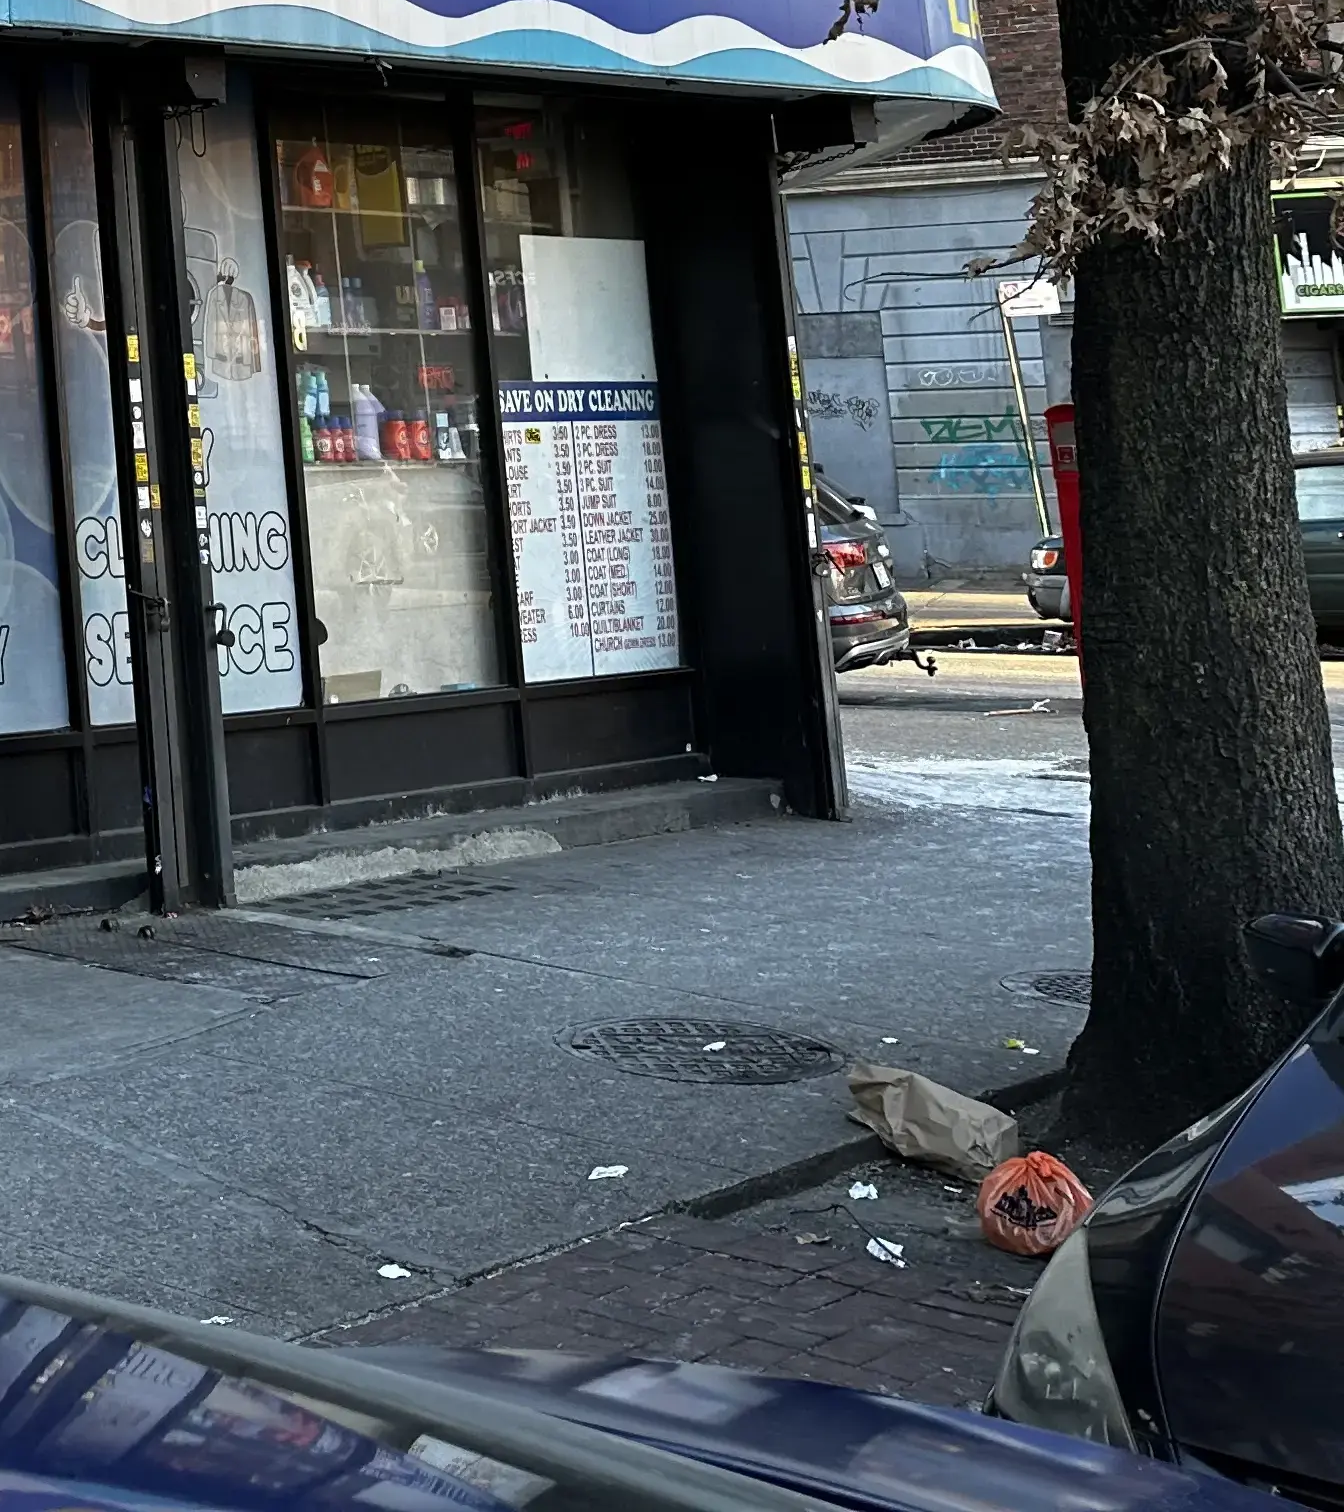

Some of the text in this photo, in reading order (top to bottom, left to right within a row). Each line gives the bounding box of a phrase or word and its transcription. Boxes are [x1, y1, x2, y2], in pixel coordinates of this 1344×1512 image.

[534, 389, 555, 412] ON
[558, 389, 585, 412] DRY
[588, 389, 655, 412] CLEANING
[552, 426, 568, 440] 3.50
[593, 424, 617, 440] DRESS
[554, 444, 569, 458] 3.50
[595, 442, 619, 457] DRESS
[555, 461, 571, 476] 3.50
[597, 459, 612, 475] SUIT
[557, 479, 573, 494] 3.50
[598, 477, 614, 492] SUIT
[559, 497, 574, 512] 3.50
[582, 494, 600, 510] JUMP
[602, 493, 617, 509] SUIT
[529, 517, 557, 533] JACKET
[560, 514, 576, 530] 3.50
[583, 511, 605, 527] DOWN
[607, 511, 632, 526] JACKET
[562, 533, 577, 548] 3.50
[585, 529, 617, 545] LEATHER
[618, 527, 643, 543] JACKET
[75, 511, 289, 580] CLING
[563, 550, 579, 565] 3.00
[586, 547, 605, 563] COAT
[565, 568, 581, 583] 3.00
[588, 565, 606, 581] COAT
[566, 586, 583, 601] 3.00
[589, 583, 608, 599] COAT
[568, 604, 584, 619] 6.00
[591, 599, 625, 616] CURTAINS
[85, 601, 294, 687] SEICE
